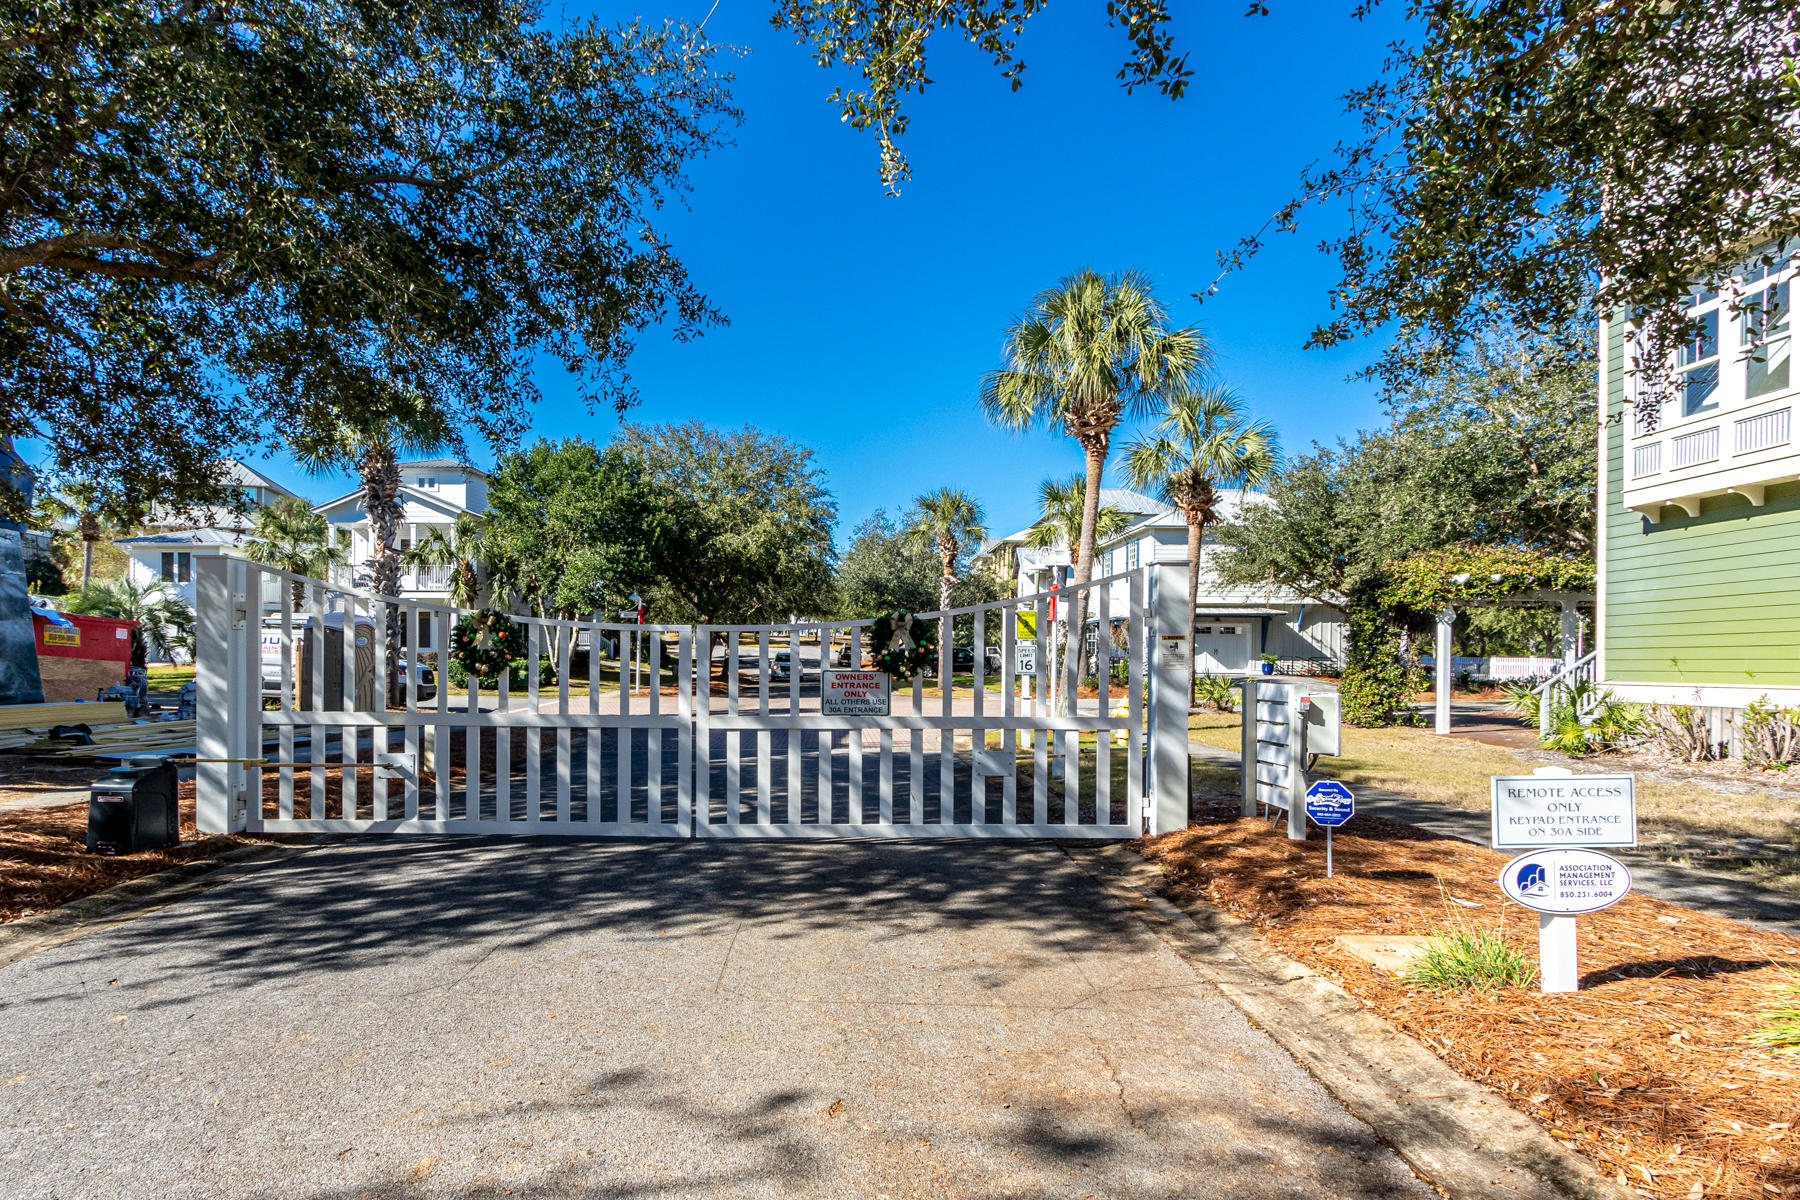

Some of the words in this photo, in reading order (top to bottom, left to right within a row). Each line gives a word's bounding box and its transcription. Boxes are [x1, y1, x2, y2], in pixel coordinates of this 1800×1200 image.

[1020, 660, 1033, 671] 16
[843, 690, 868, 698] ONLY
[825, 698, 839, 706] ALL
[1508, 788, 1565, 798] REMOTE
[1570, 787, 1622, 797] ACCESS
[1547, 802, 1582, 813] ONLY
[1509, 816, 1555, 825] KEYPAD
[1559, 815, 1622, 824] ENTRANCE
[1528, 828, 1545, 837] ON
[1549, 828, 1573, 836] 30A
[1576, 827, 1604, 836] SIDE
[1559, 864, 1612, 872] ASSOCIATION
[1559, 871, 1616, 879] MANAGEMENT
[1559, 879, 1597, 887] SERVICES,
